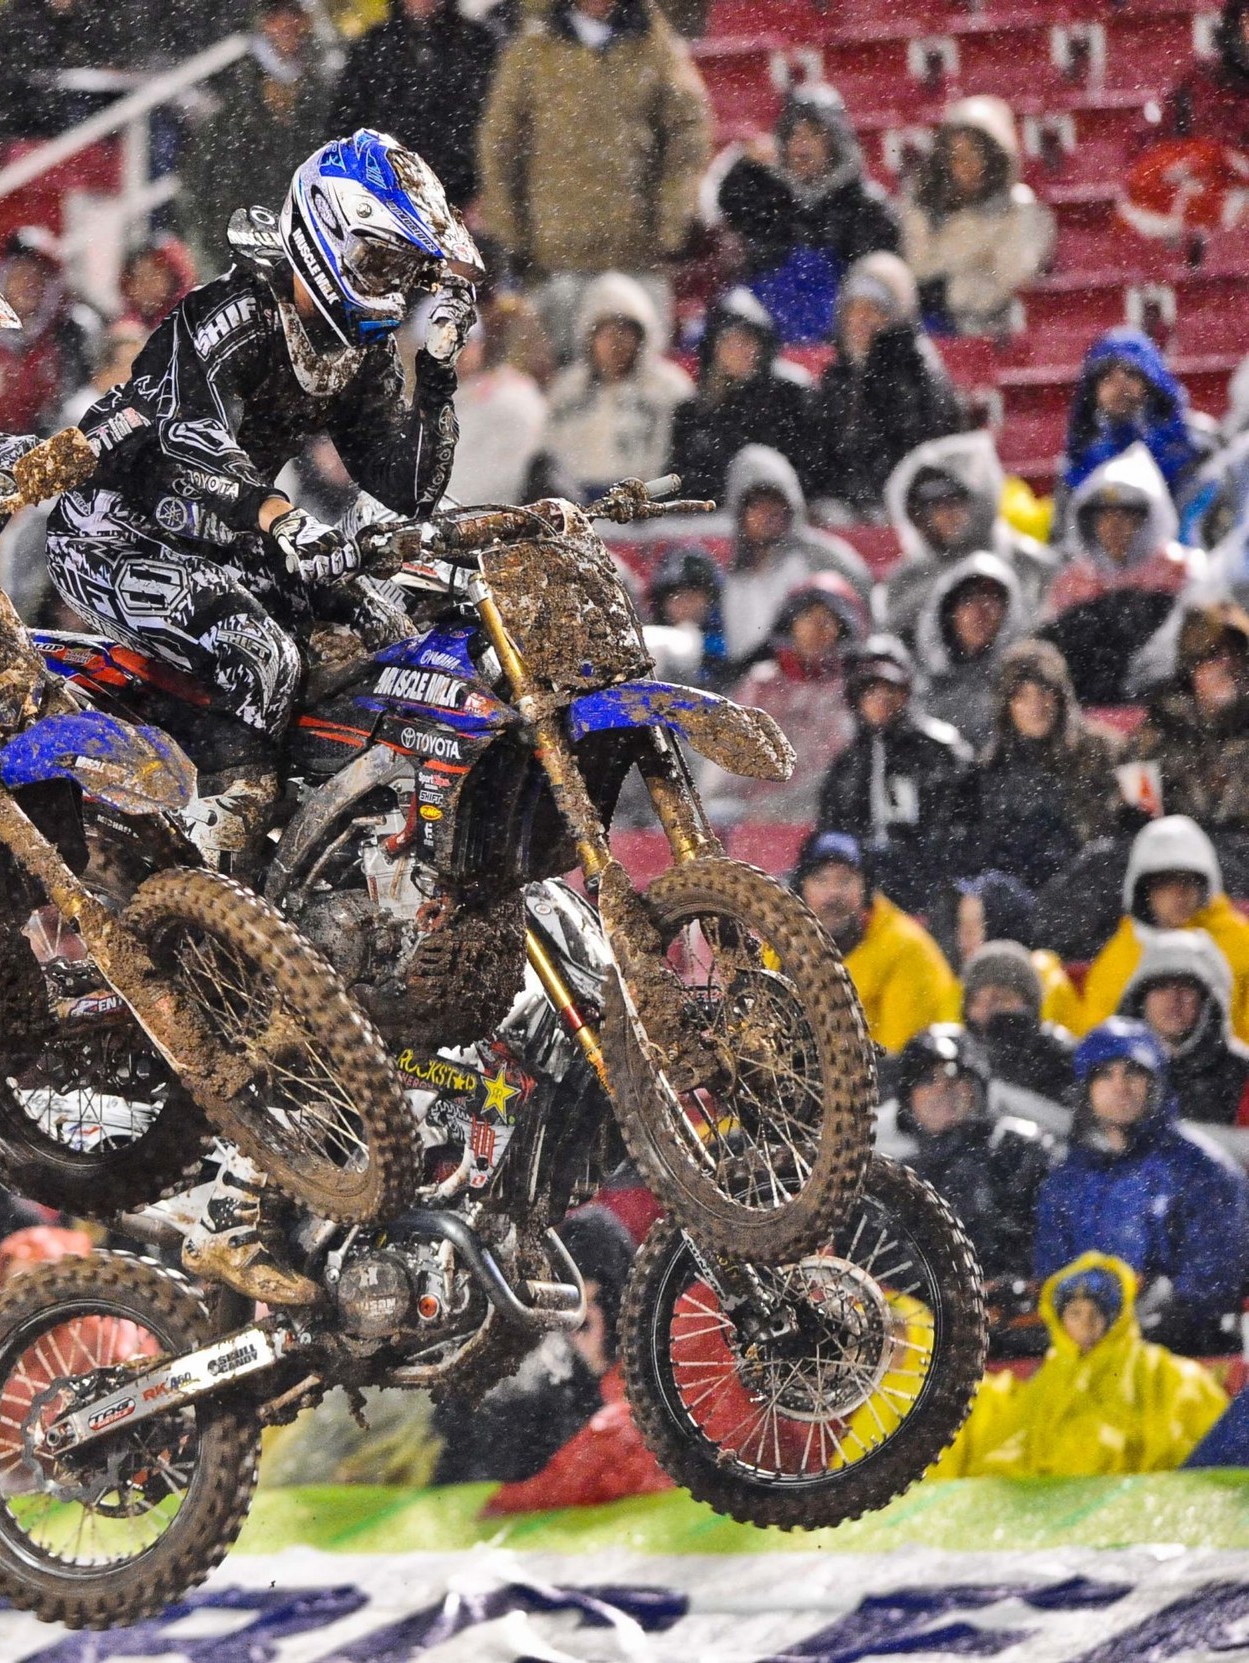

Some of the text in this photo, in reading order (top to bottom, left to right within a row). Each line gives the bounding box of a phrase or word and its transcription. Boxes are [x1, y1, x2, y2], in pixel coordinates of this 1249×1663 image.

[292, 227, 341, 305] MUSCLE MILK
[194, 296, 258, 358] SHIF
[416, 437, 456, 505] TOYOTA
[187, 468, 240, 500] TOYOTA
[428, 651, 462, 670] YAMAHA
[373, 667, 467, 708] MUSCLE MILK
[415, 732, 462, 760] TOYOTA
[420, 790, 443, 804] SHIFT
[218, 1344, 257, 1365] SKULL
[221, 1351, 258, 1373] CANDY
[141, 1381, 168, 1402] RK
[90, 1400, 131, 1422] TAG
